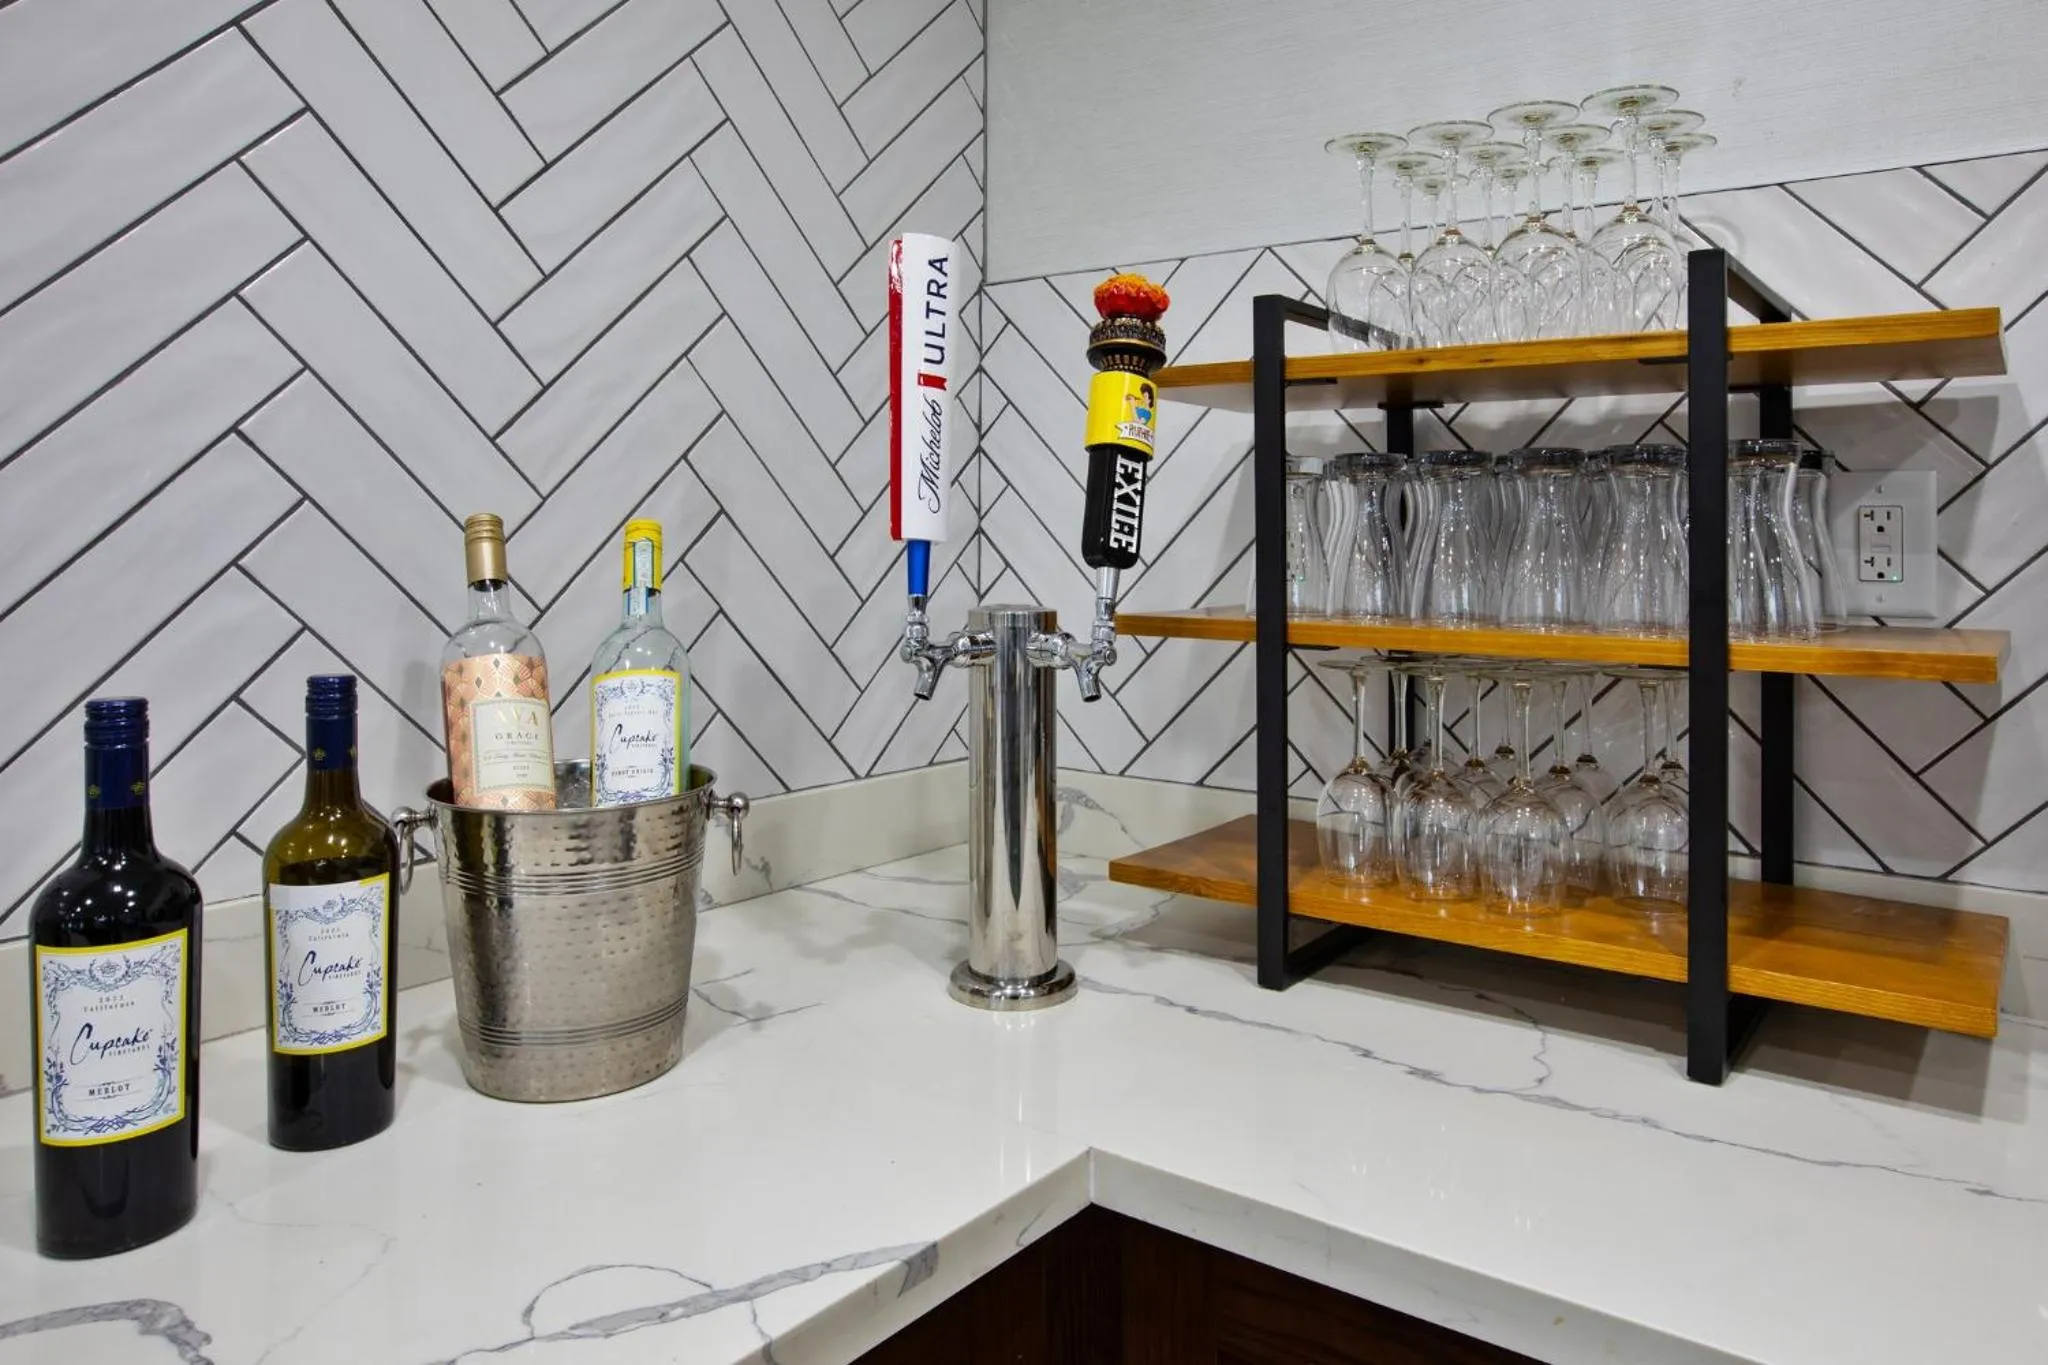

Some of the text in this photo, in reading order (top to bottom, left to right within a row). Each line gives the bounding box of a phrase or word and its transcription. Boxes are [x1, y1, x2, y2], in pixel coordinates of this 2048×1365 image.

[918, 255, 949, 514] Michelob ULTRA
[1109, 454, 1144, 554] EXILE
[495, 731, 539, 741] GRACE
[609, 723, 657, 754] Cupcake
[298, 950, 361, 986] Cupcake
[312, 1003, 346, 1012] MERLOT
[69, 1022, 150, 1065] Cupcake
[89, 1083, 130, 1096] MERLOT
